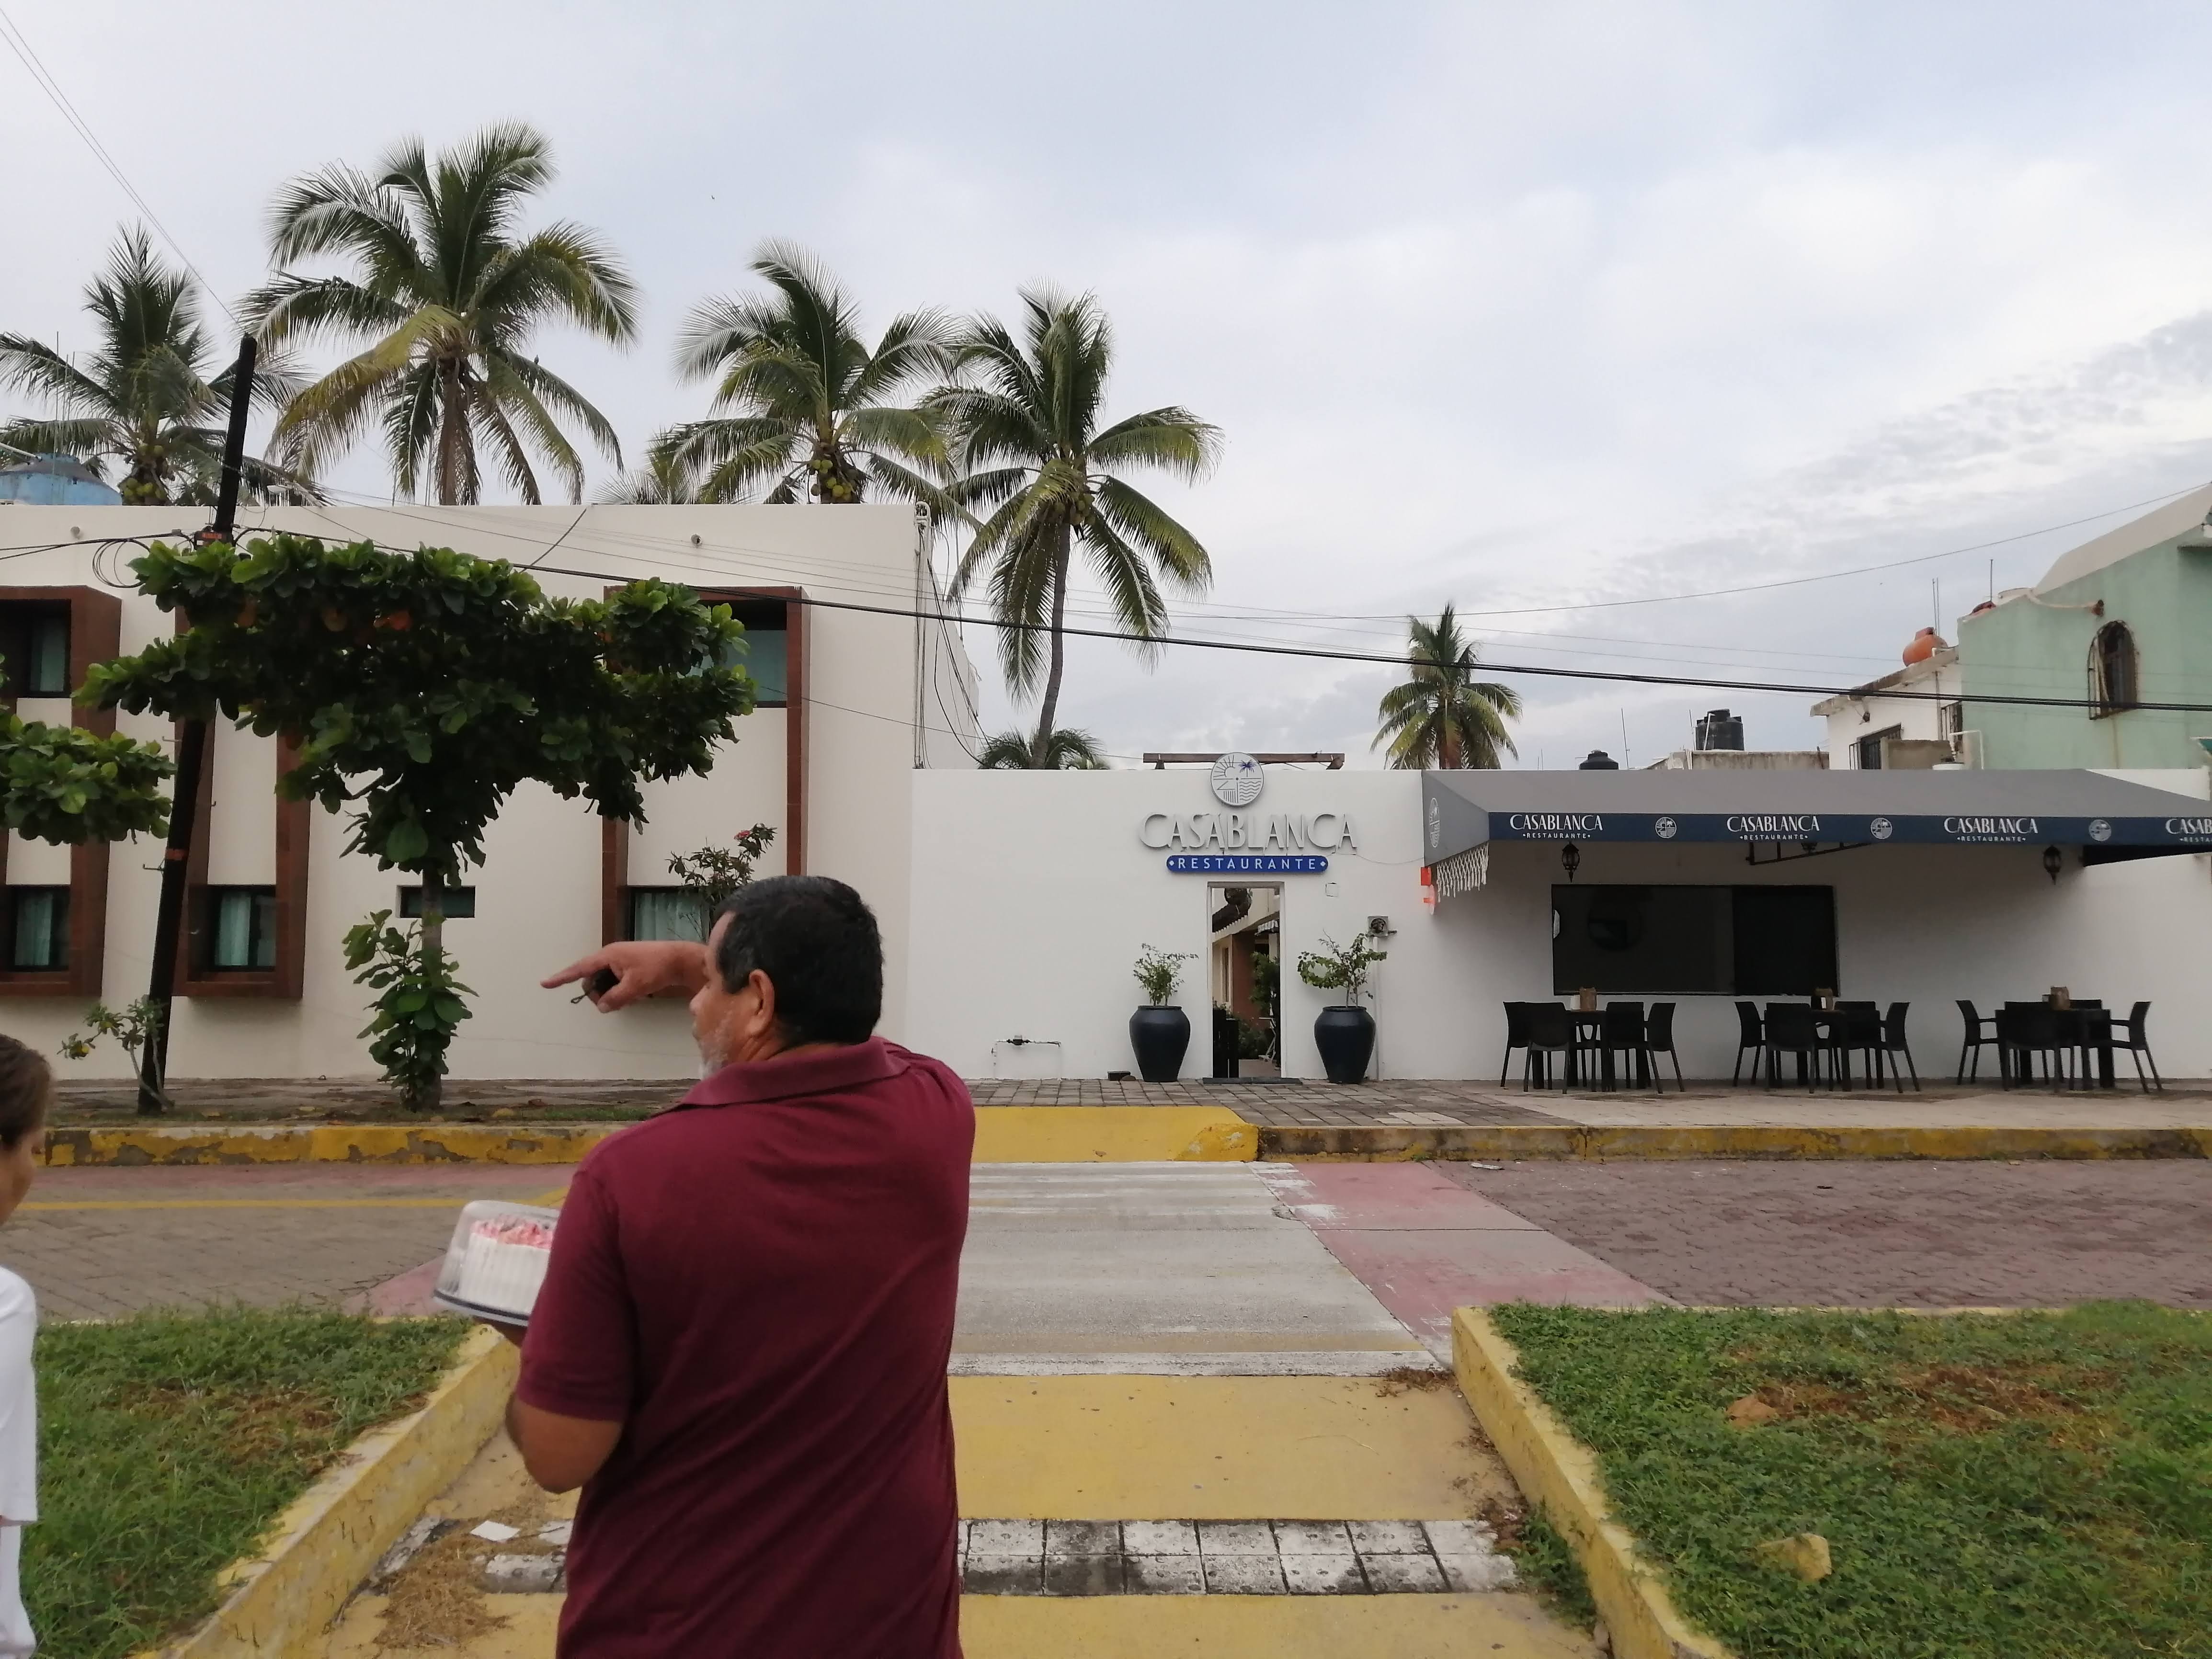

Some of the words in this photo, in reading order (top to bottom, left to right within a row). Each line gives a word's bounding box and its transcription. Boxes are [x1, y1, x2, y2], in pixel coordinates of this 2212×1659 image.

[1139, 813, 1357, 848] CASABLANCA
[1510, 814, 1603, 831] CASABLANCA
[1727, 816, 1820, 832] CASABLANCA
[1944, 817, 2038, 834] CASABLANCA
[1178, 858, 1315, 869] RESTAURANTE
